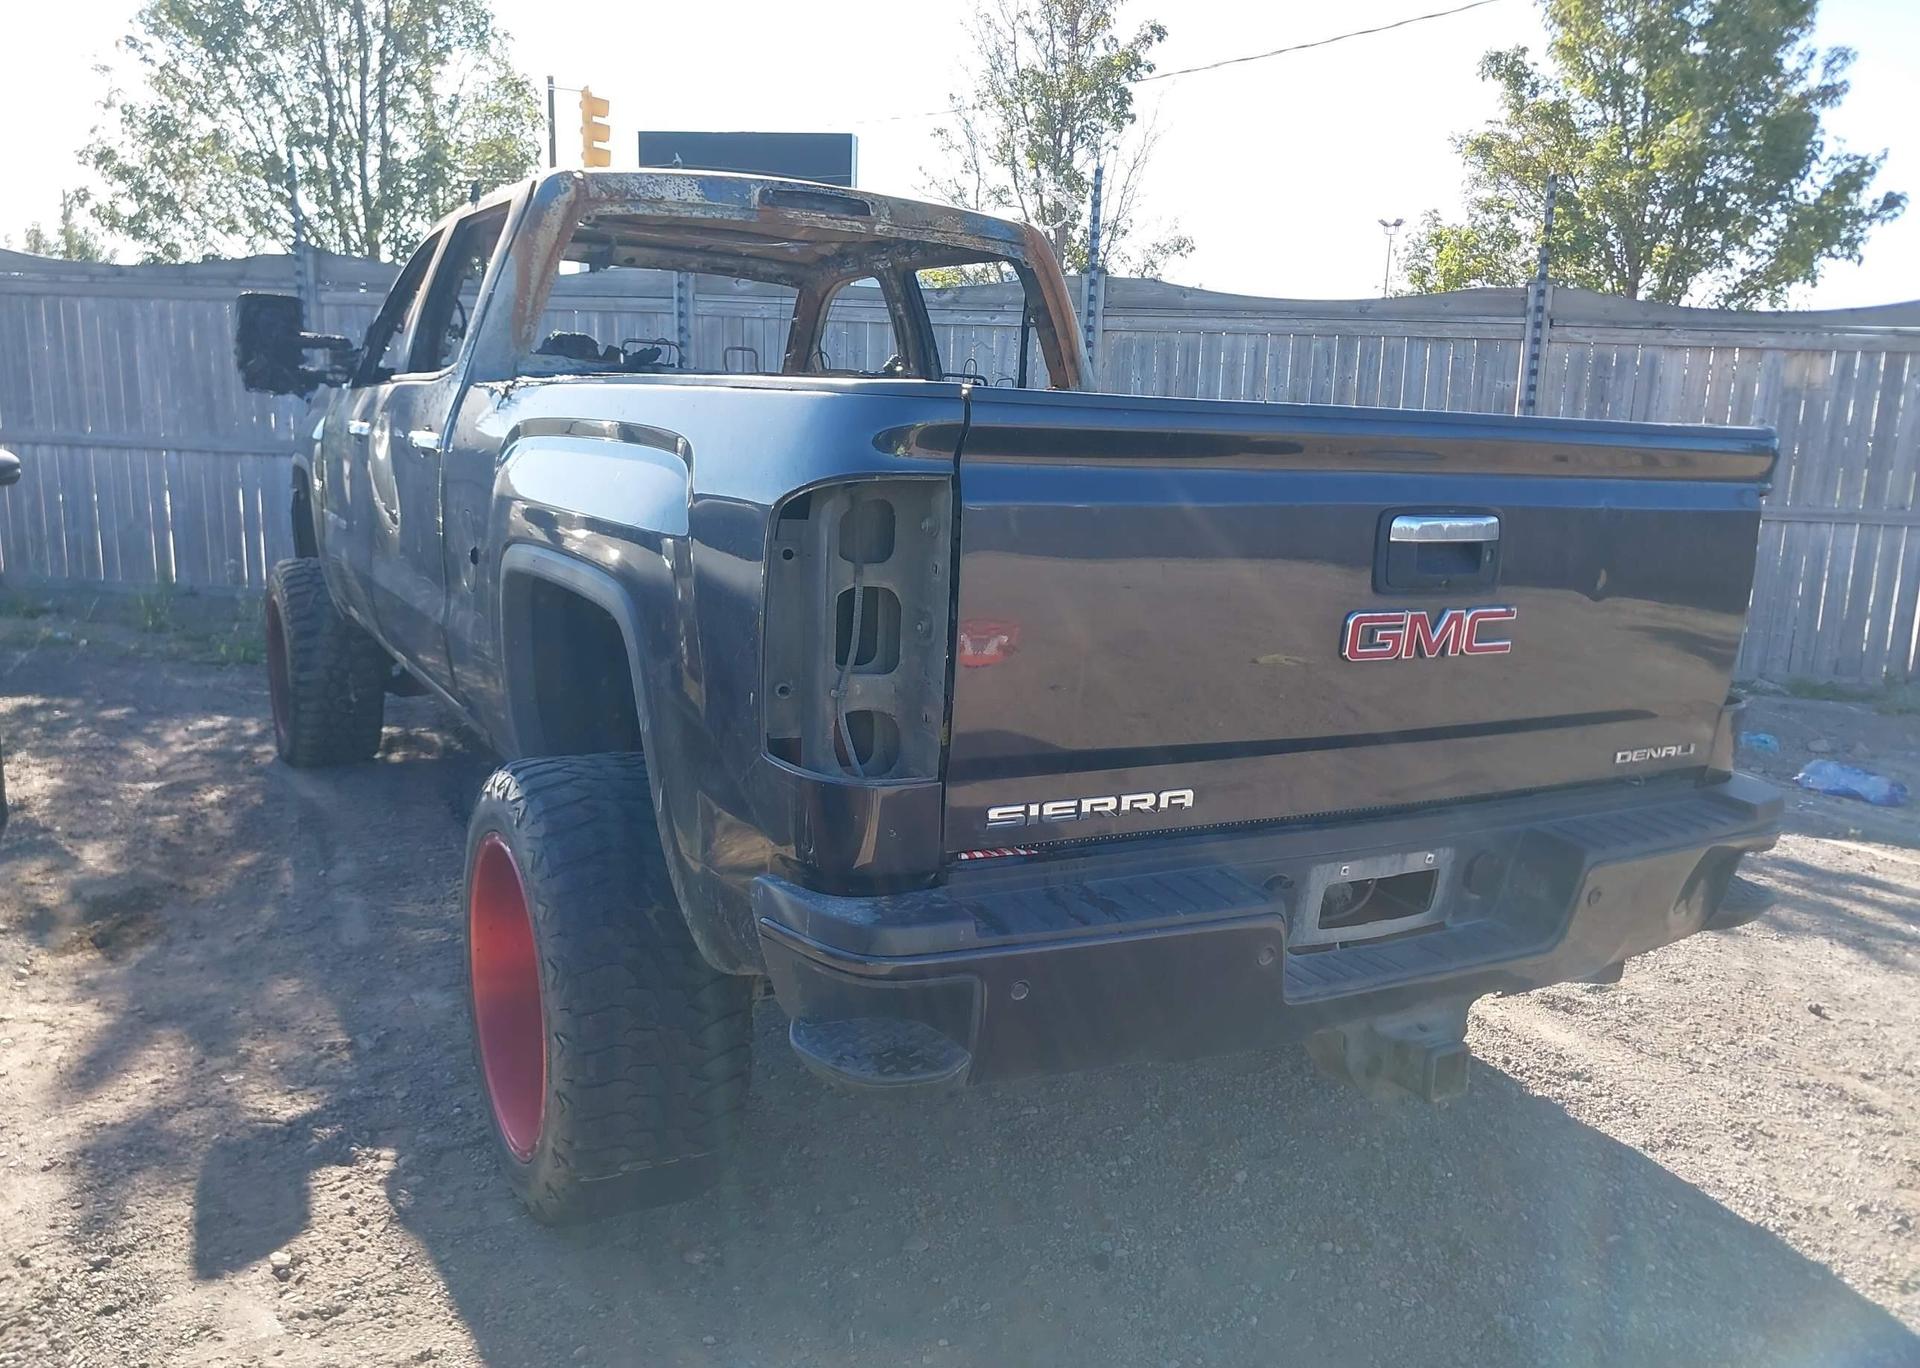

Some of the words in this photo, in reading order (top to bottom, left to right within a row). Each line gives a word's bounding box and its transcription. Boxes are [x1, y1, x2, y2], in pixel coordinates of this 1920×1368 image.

[1343, 607, 1518, 661] GMC
[1615, 743, 1696, 764] DENALI
[986, 788, 1195, 829] SIERRA
